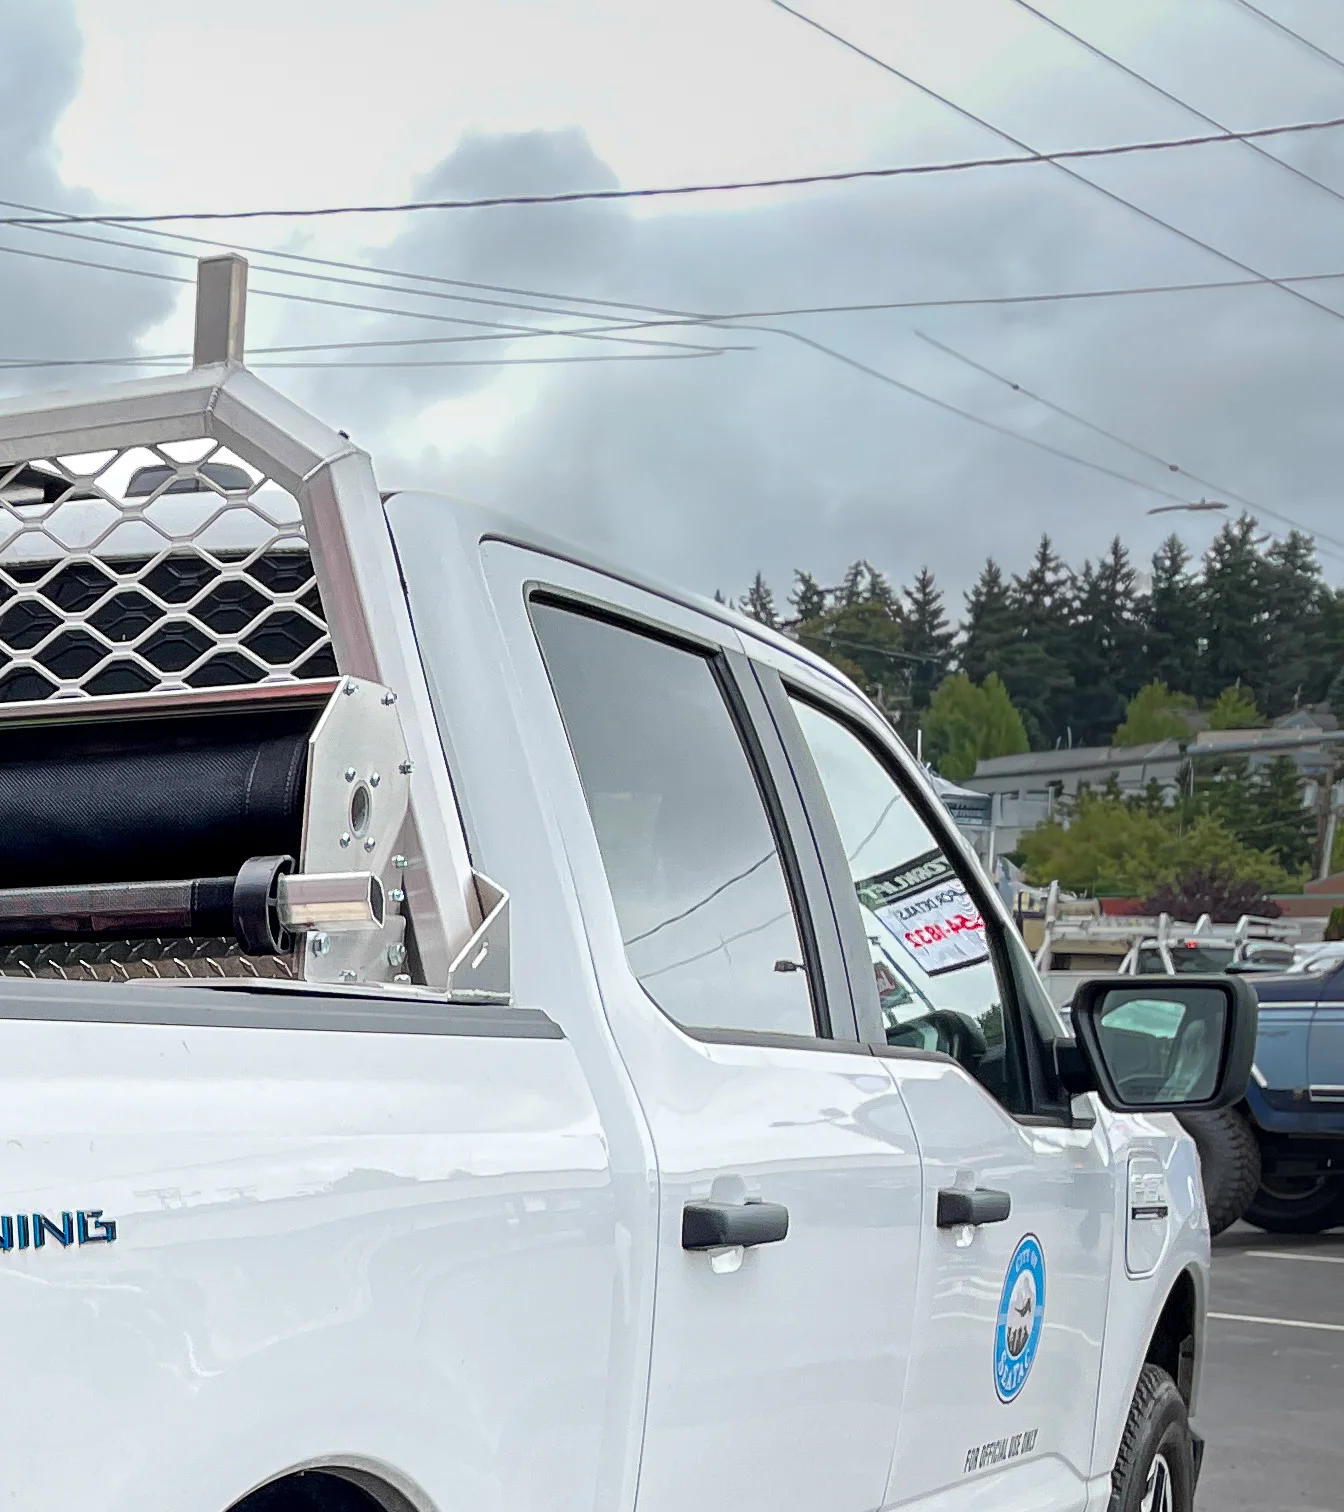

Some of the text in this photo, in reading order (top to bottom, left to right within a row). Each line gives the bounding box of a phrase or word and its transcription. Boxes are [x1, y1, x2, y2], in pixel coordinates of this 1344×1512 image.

[964, 1448, 979, 1473] FOR
[979, 1439, 1007, 1468] OFFICIAL
[1021, 1428, 1039, 1456] ONLY
